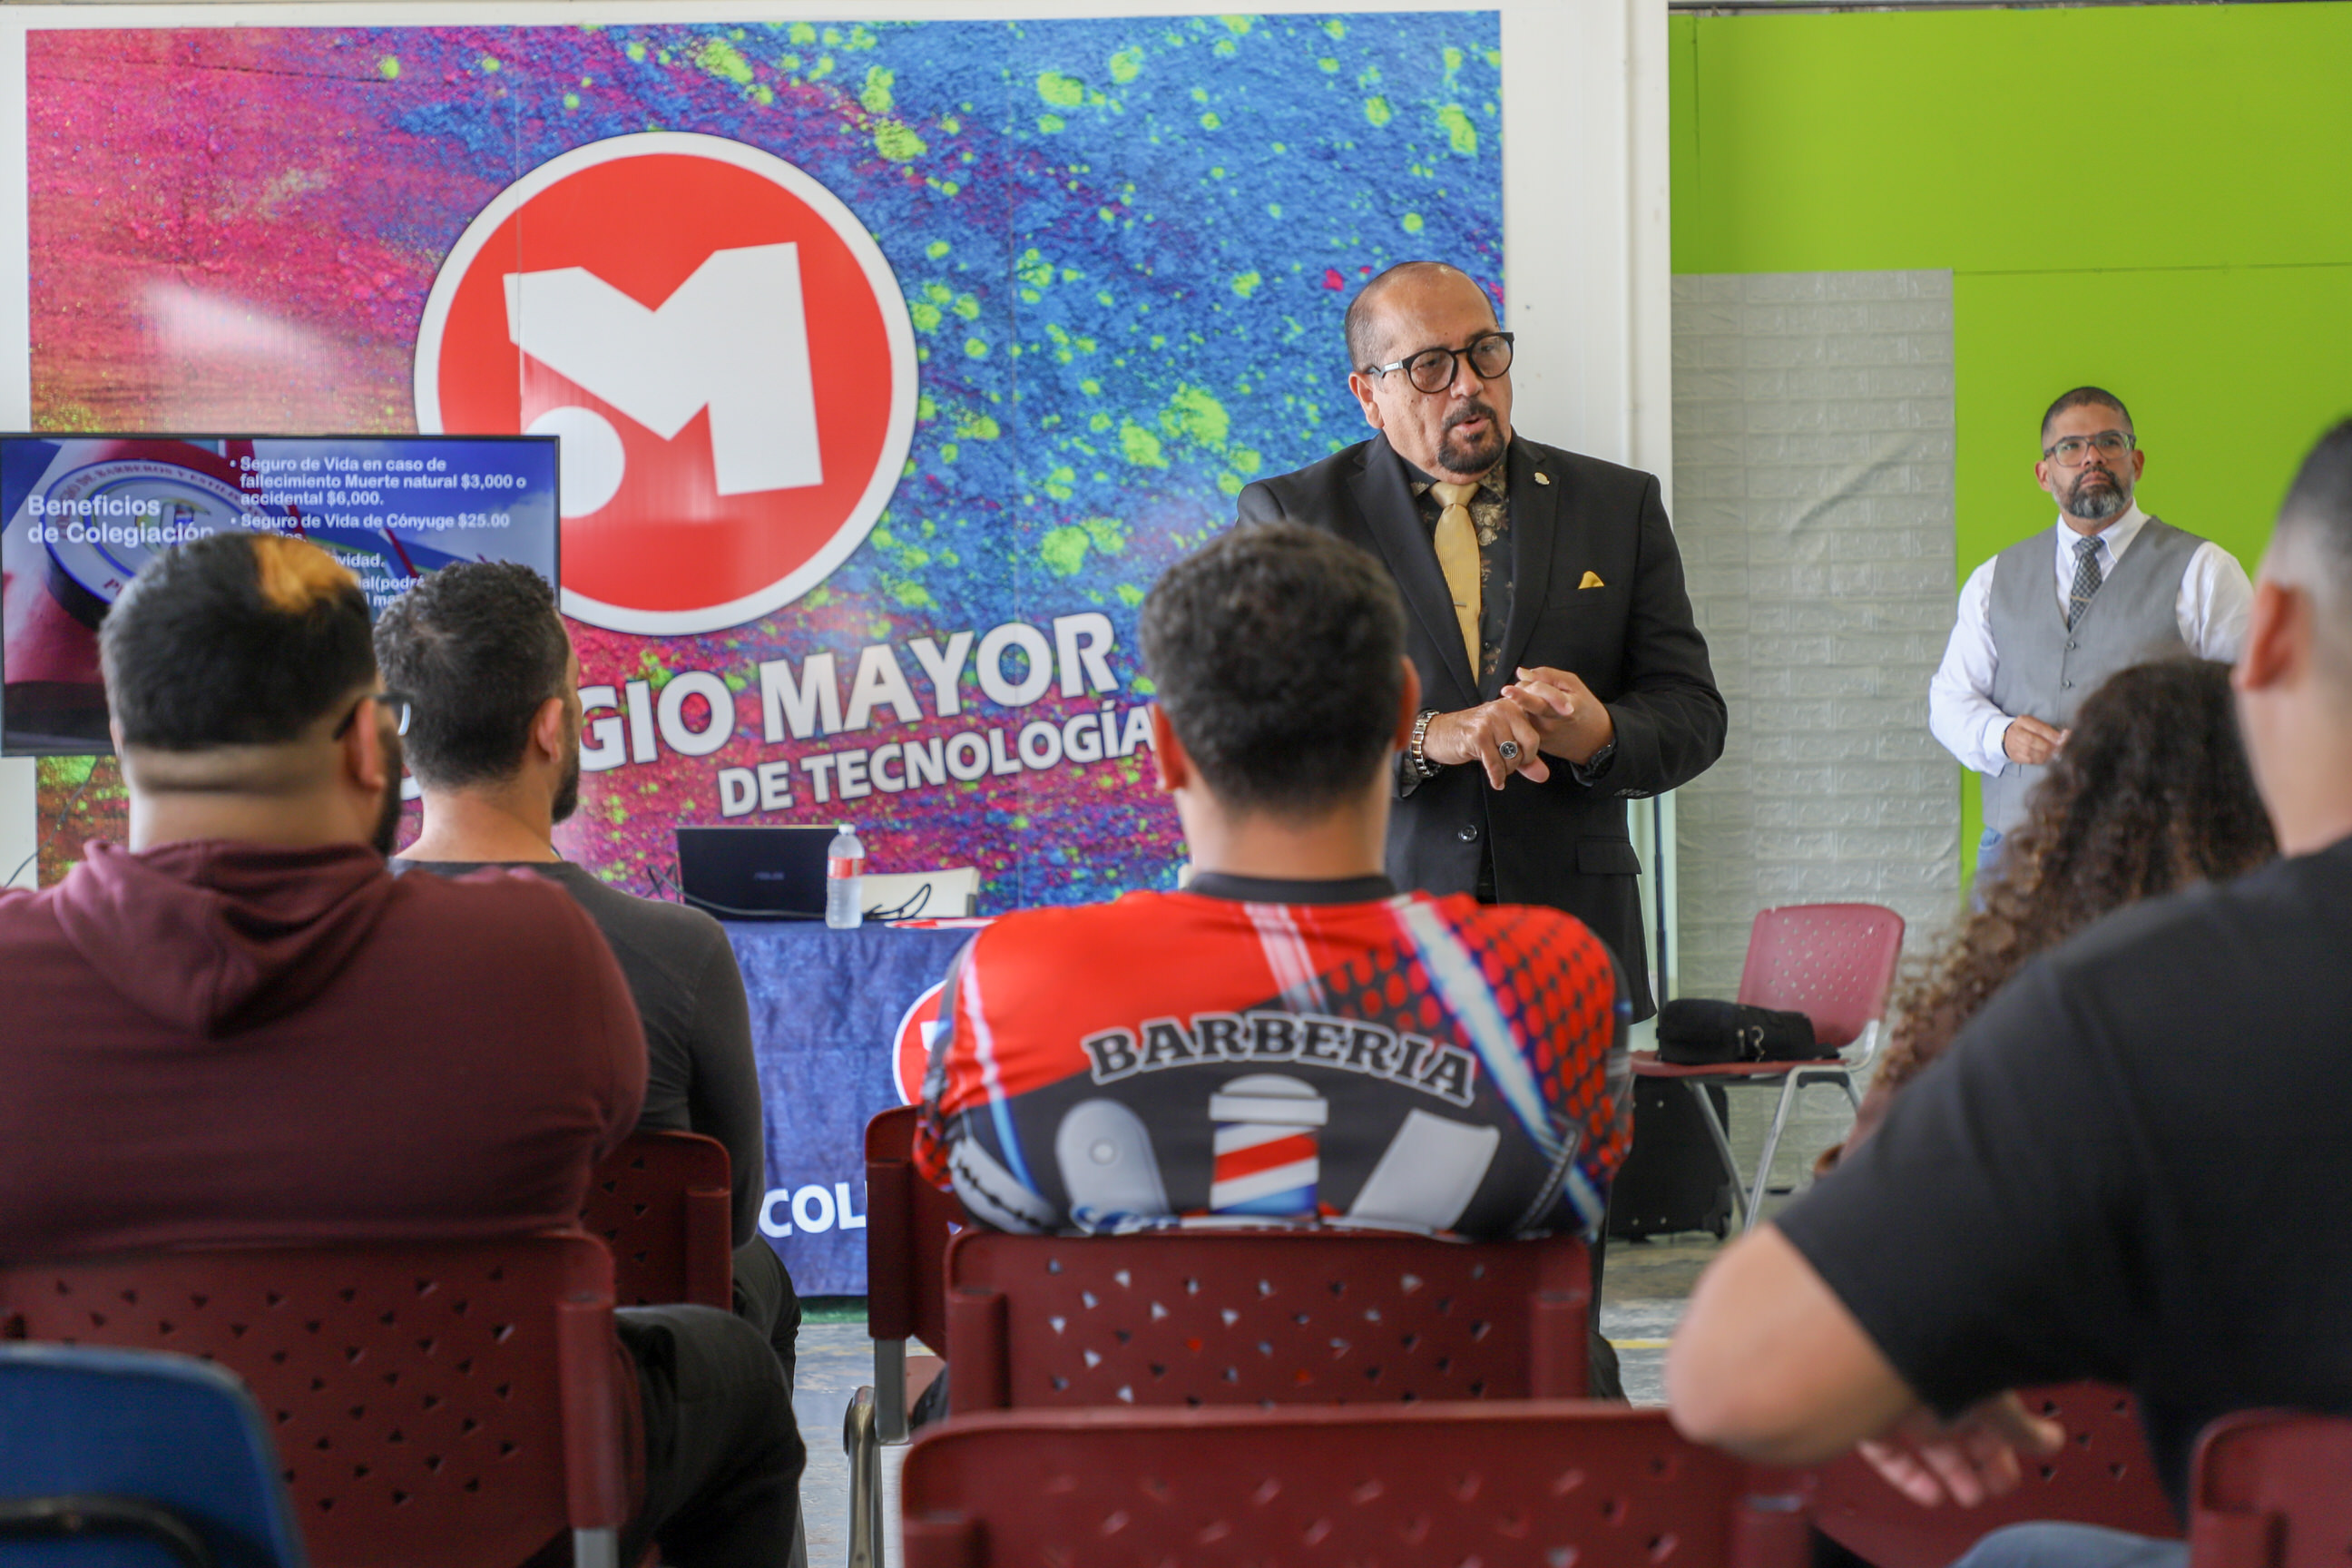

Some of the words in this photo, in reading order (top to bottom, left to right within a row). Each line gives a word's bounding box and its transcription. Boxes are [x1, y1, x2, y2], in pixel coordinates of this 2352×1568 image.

[240, 456, 297, 474] Seguro
[300, 457, 320, 472] de
[324, 457, 359, 472] Vida
[362, 461, 383, 472] en
[386, 461, 424, 472] caso
[426, 457, 446, 472] de
[240, 475, 341, 489] fallecimiento
[345, 475, 400, 489] Muerte
[403, 475, 457, 489] natural
[460, 474, 514, 491] $3,000
[516, 478, 526, 488] o
[28, 495, 160, 516] Beneficios
[240, 491, 323, 505] accidental
[27, 522, 58, 544] de
[66, 521, 214, 548] Colegiación
[240, 514, 298, 530] Seguro
[301, 514, 320, 528] de
[325, 514, 359, 528] Vida
[362, 514, 383, 528] de
[387, 514, 455, 532] Cónyuge
[457, 513, 510, 529] $25.00
[578, 671, 735, 773] GIO
[759, 612, 1120, 744] MAYOR
[718, 765, 793, 818] DE
[800, 701, 1156, 803] TECNOLOGÍA
[1082, 1010, 1477, 1108] BARBERIA
[759, 1181, 868, 1239] COL
